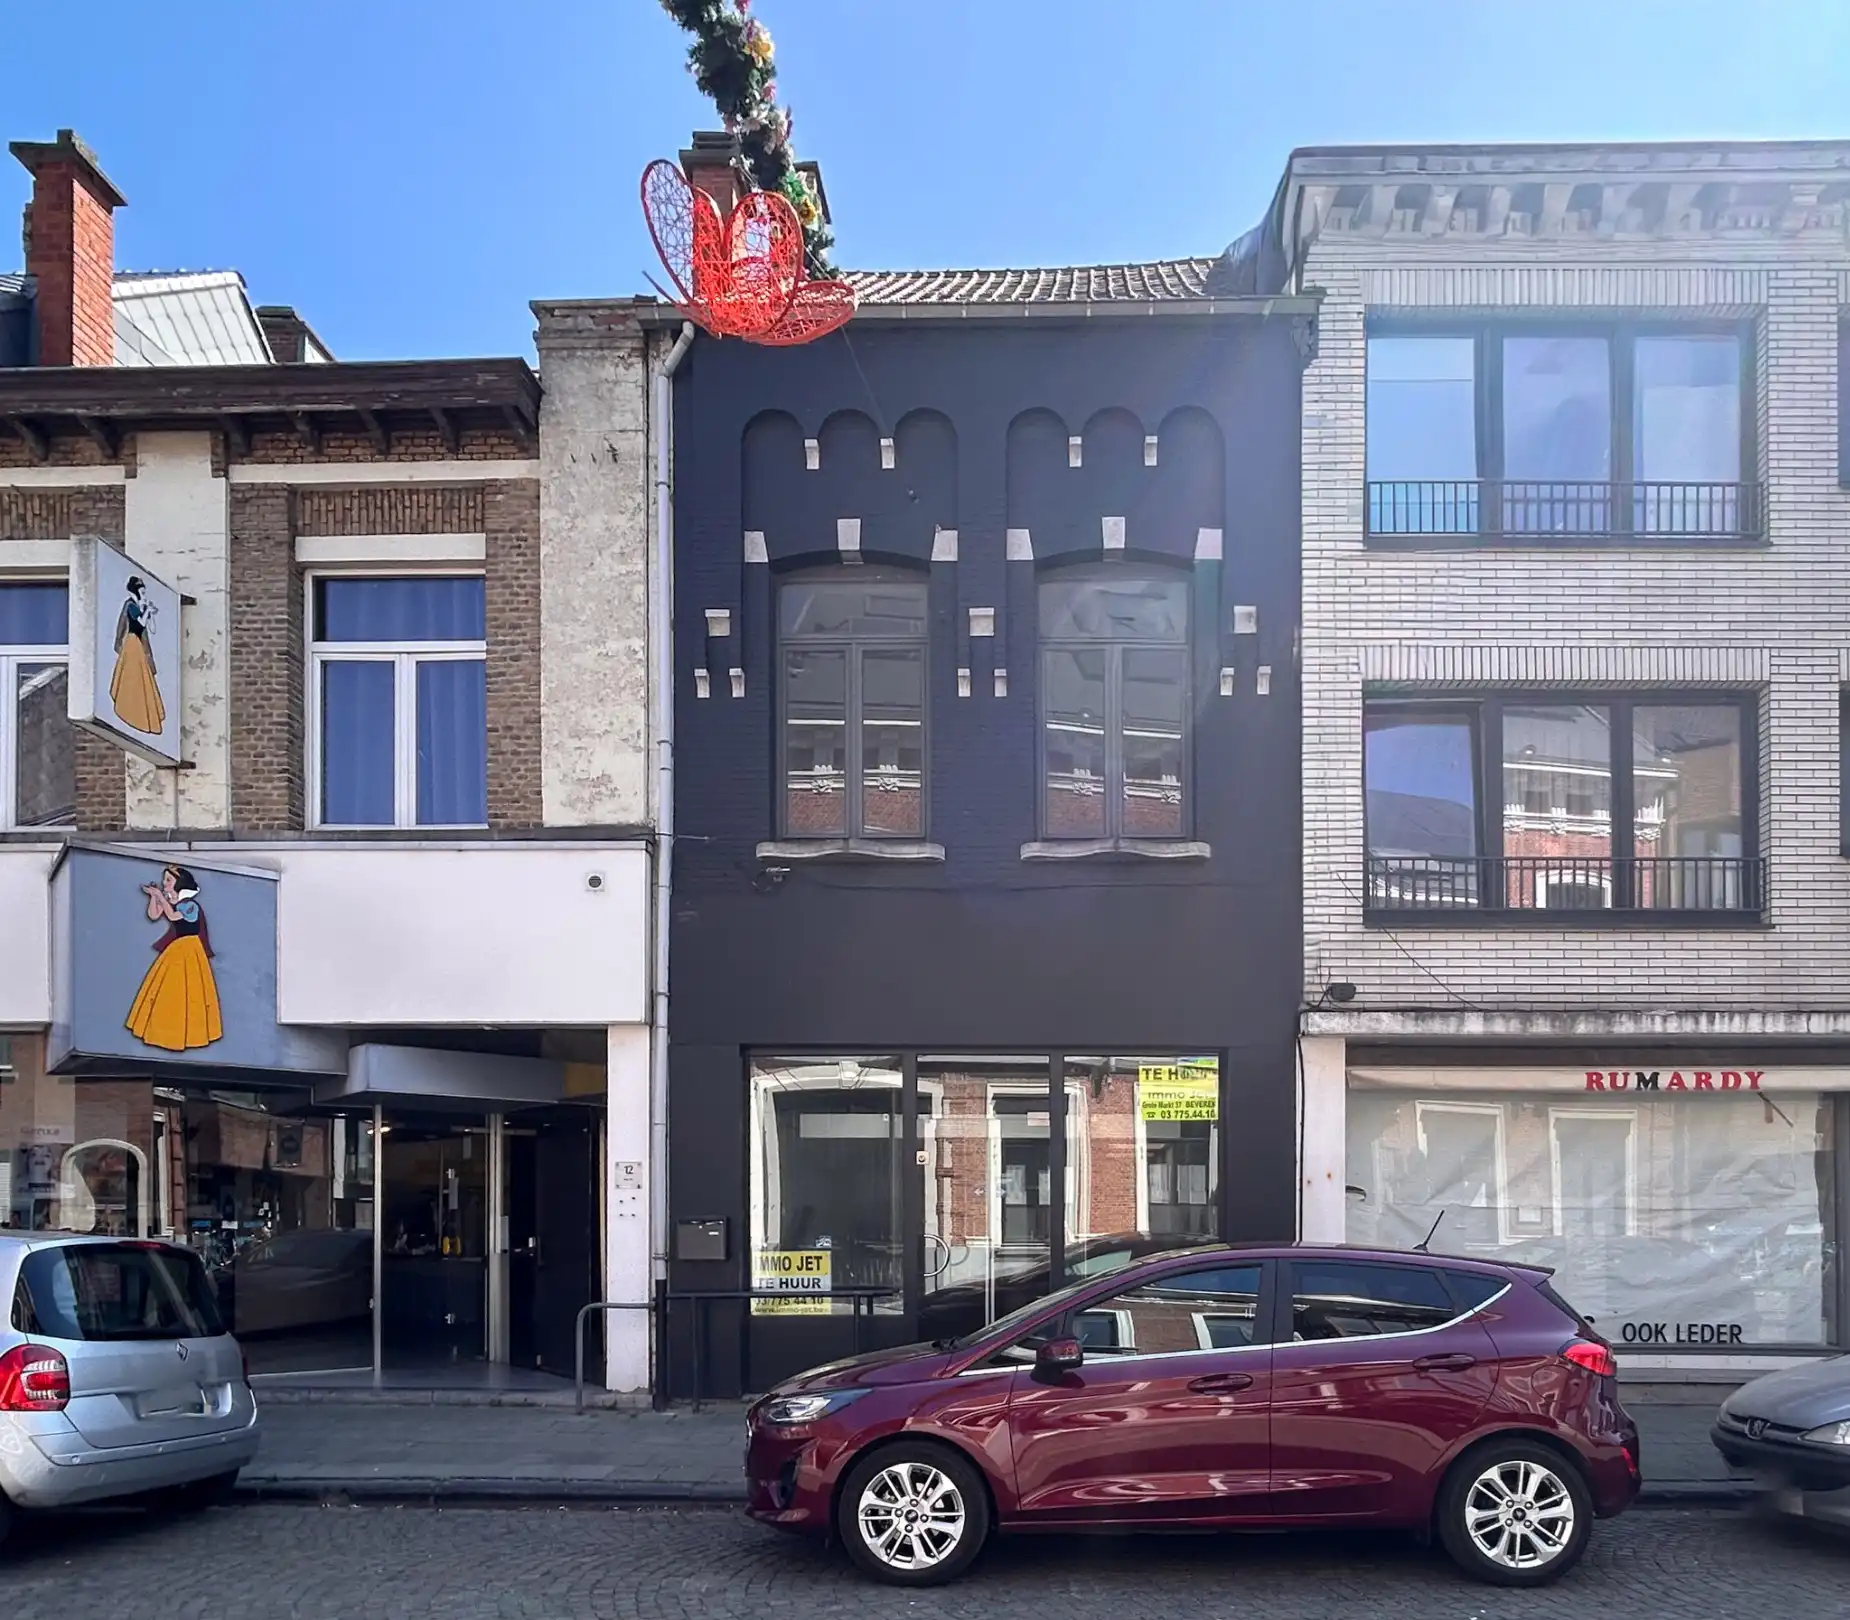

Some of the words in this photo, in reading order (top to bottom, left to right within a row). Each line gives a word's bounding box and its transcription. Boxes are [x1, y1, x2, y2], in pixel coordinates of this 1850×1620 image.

[1142, 1068, 1162, 1081] TE
[1168, 1068, 1217, 1081] HU
[1585, 1071, 1765, 1091] RUMARDY
[1160, 1110, 1172, 1119] 03
[796, 1255, 823, 1272] JET
[779, 1277, 821, 1290] HUUR
[1622, 1323, 1668, 1343] OOK
[1676, 1323, 1742, 1344] LEDER
